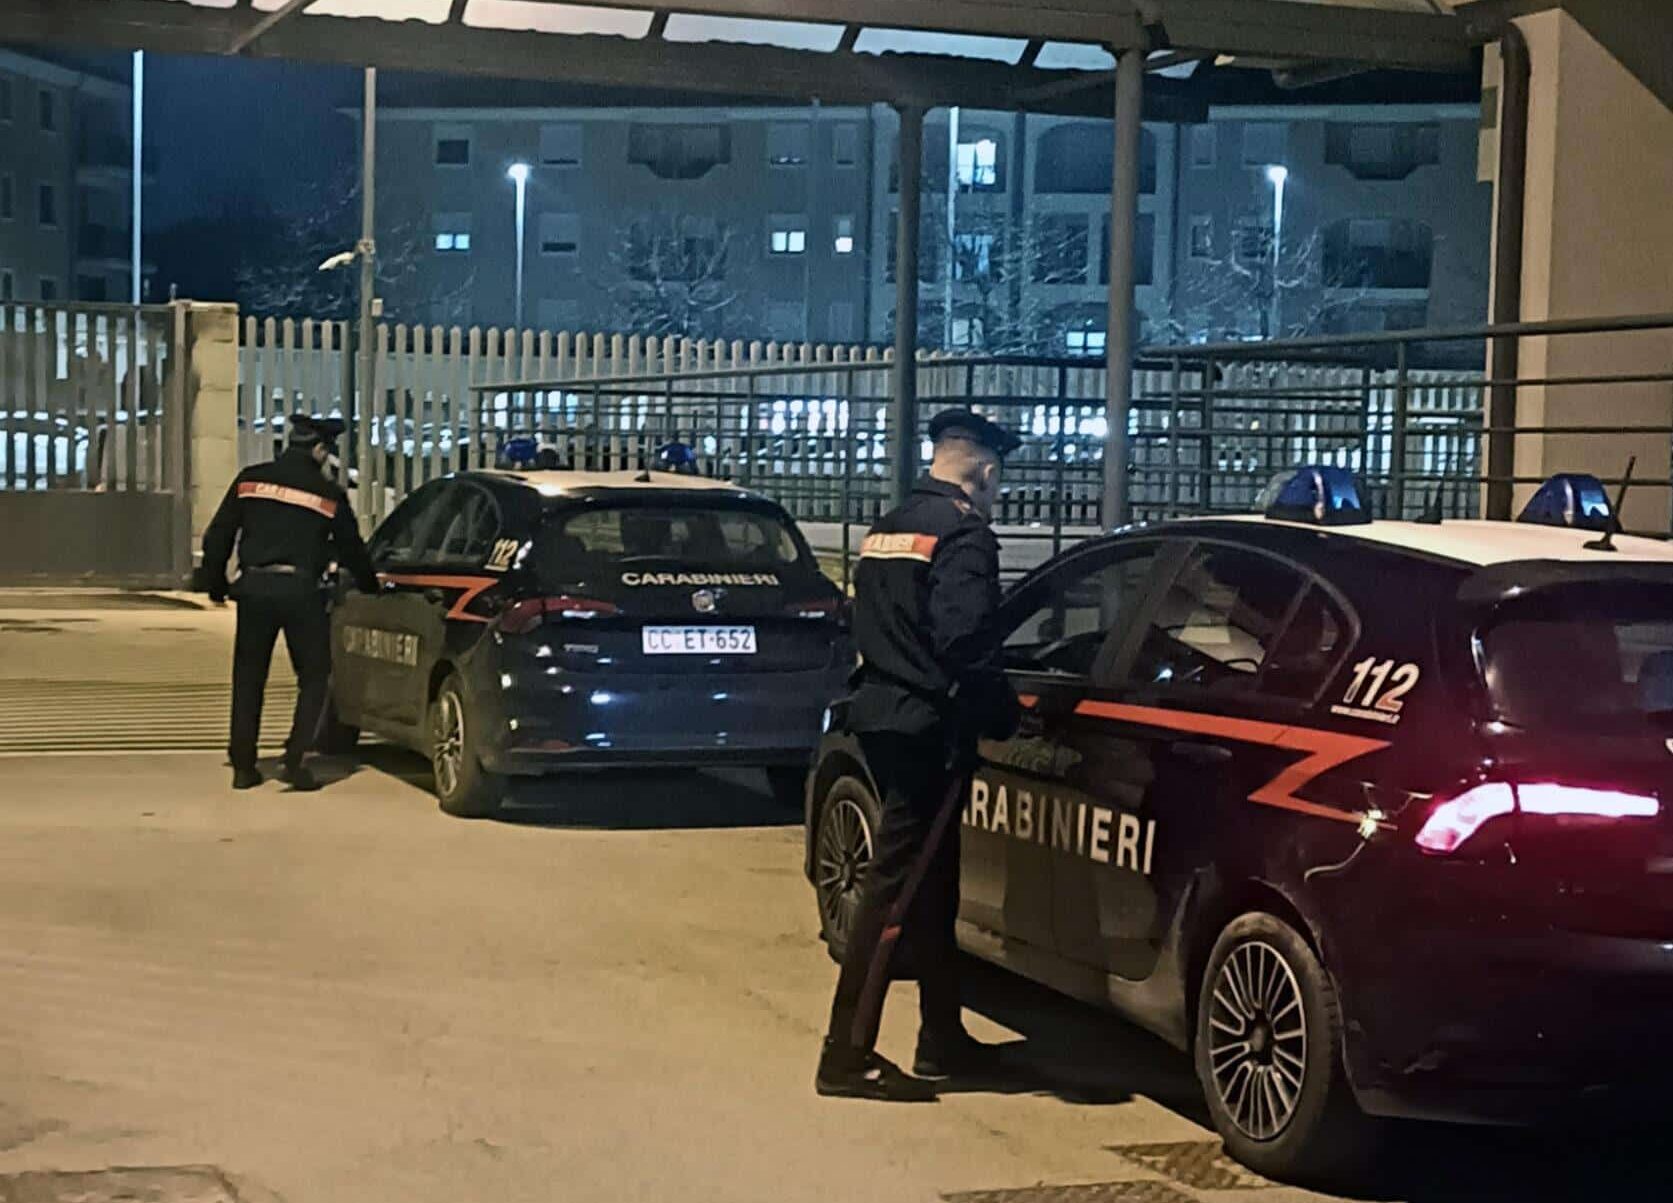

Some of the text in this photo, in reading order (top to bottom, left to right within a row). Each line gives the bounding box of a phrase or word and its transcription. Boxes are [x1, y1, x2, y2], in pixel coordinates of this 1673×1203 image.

[621, 572, 780, 586] CARABINIERI
[648, 627, 672, 650] CC
[1343, 656, 1420, 713] 112
[962, 778, 1156, 875] RABINIERI
